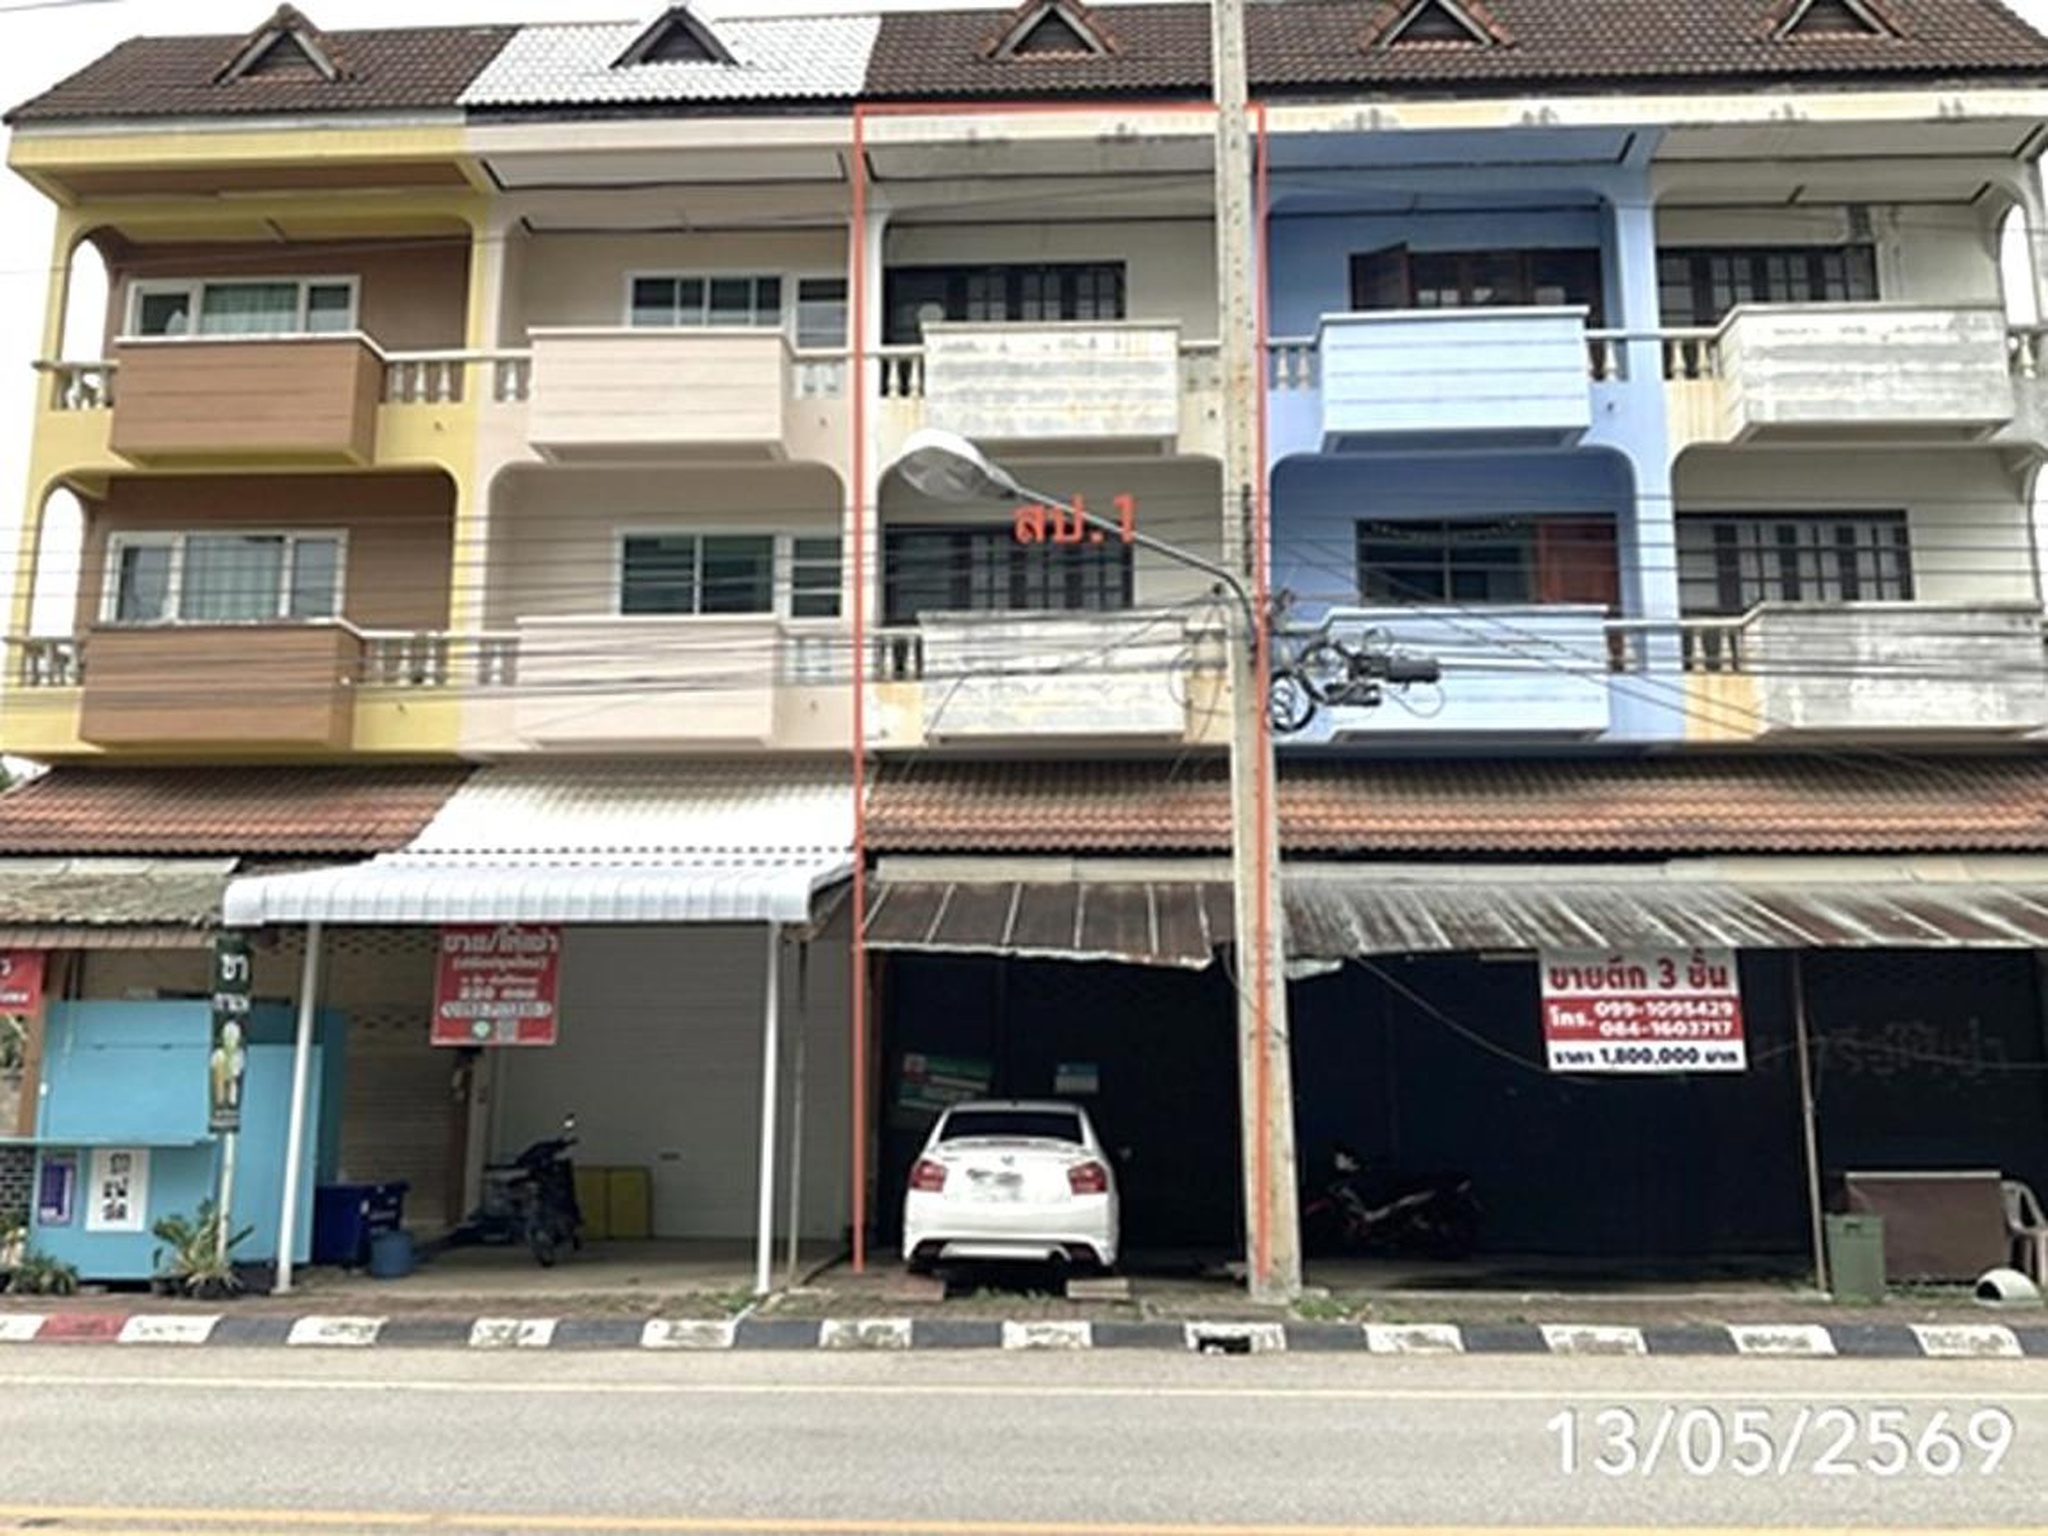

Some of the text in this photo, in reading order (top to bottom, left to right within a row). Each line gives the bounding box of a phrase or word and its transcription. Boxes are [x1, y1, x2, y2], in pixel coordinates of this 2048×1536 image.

[1551, 947, 1729, 990] ขายตึก 3 ชั้น
